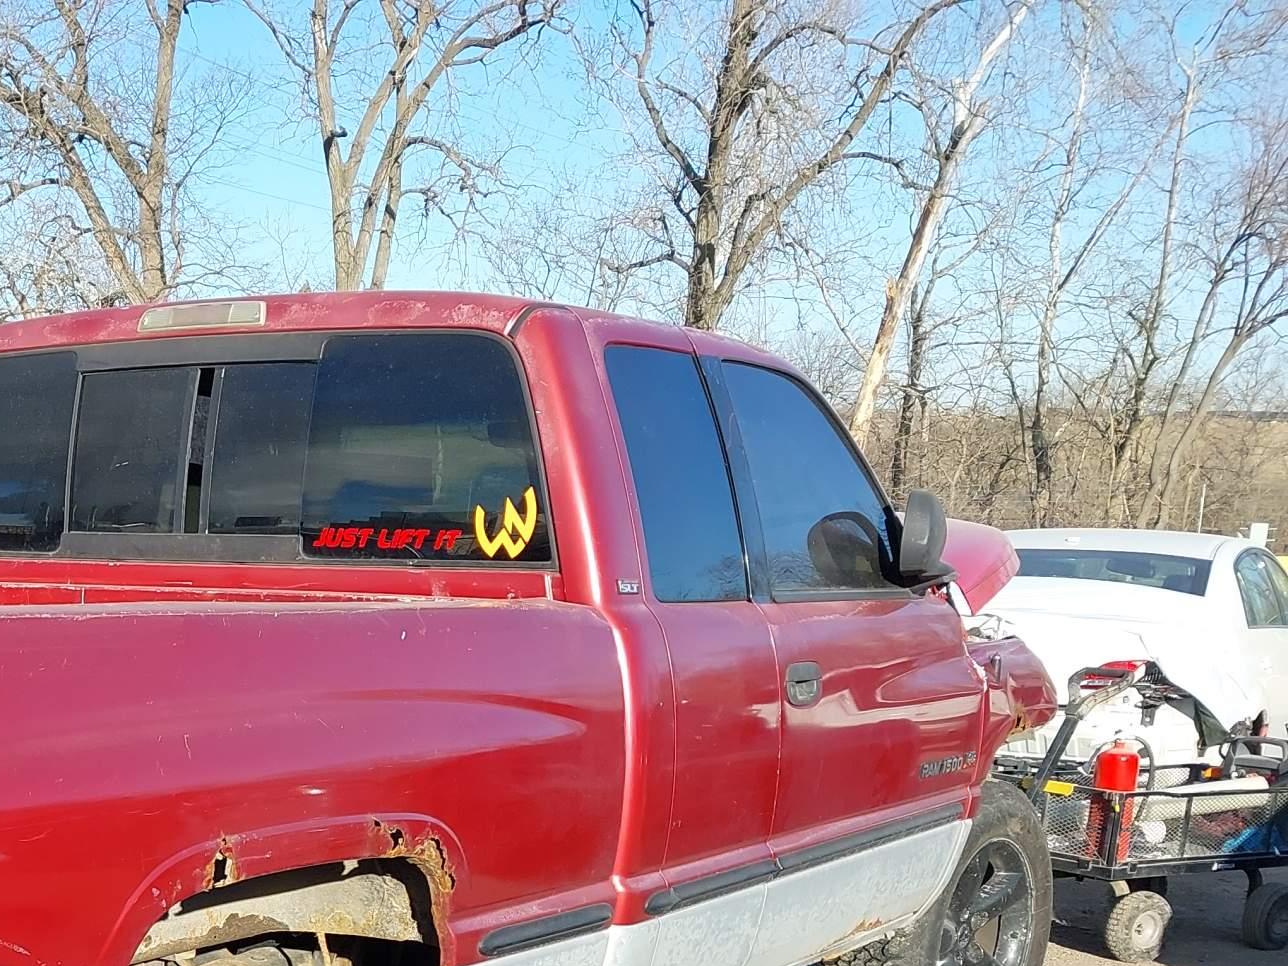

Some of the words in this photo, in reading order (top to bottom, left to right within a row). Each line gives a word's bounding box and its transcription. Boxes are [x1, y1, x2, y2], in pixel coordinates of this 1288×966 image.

[313, 527, 374, 548] JUST
[376, 528, 431, 550] LIFT
[433, 529, 463, 551] IT
[943, 757, 964, 774] 1500
